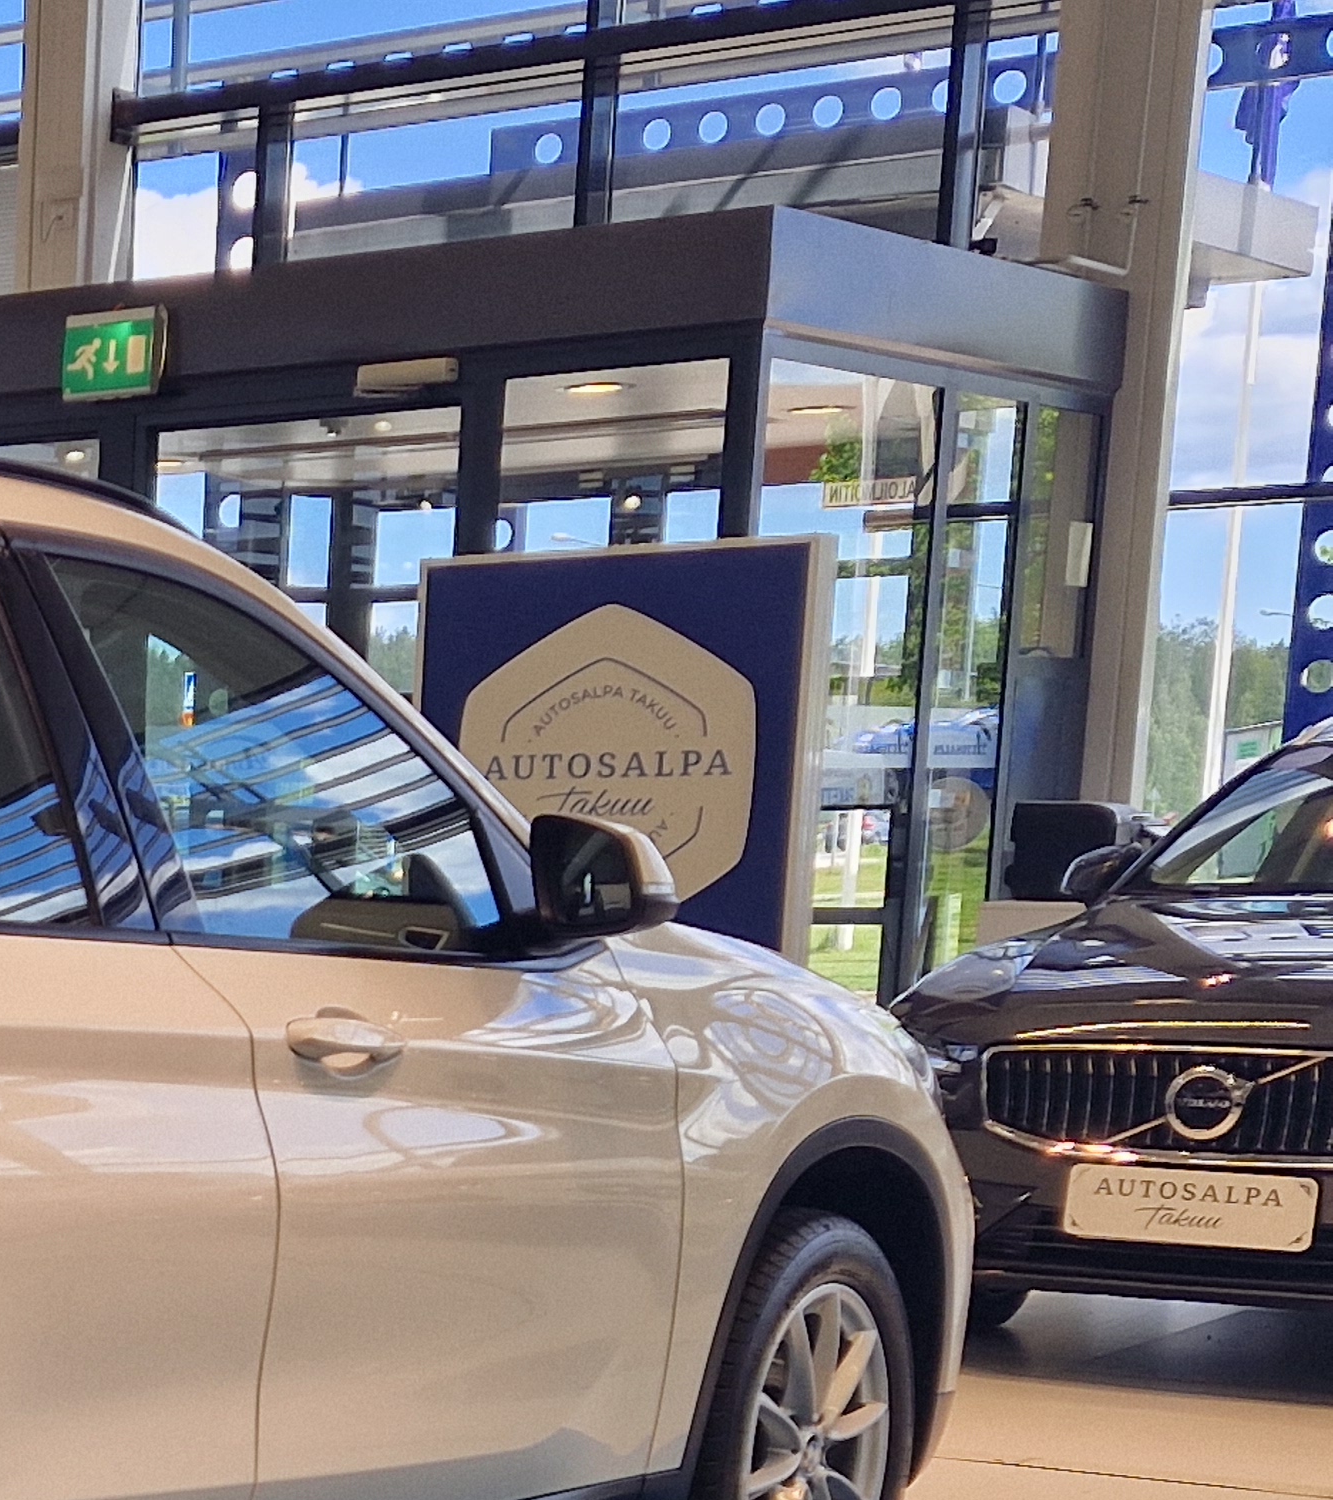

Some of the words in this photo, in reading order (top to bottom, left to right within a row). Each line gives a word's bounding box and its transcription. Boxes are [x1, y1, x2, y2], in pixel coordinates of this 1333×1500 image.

[533, 684, 624, 737] AUTOSALPA
[630, 687, 678, 732] TAKUU
[485, 748, 733, 781] AUTOSALPA
[535, 785, 656, 817] Takuu
[1093, 1176, 1284, 1208] AUTOSALPA
[1133, 1204, 1224, 1231] Takuu
